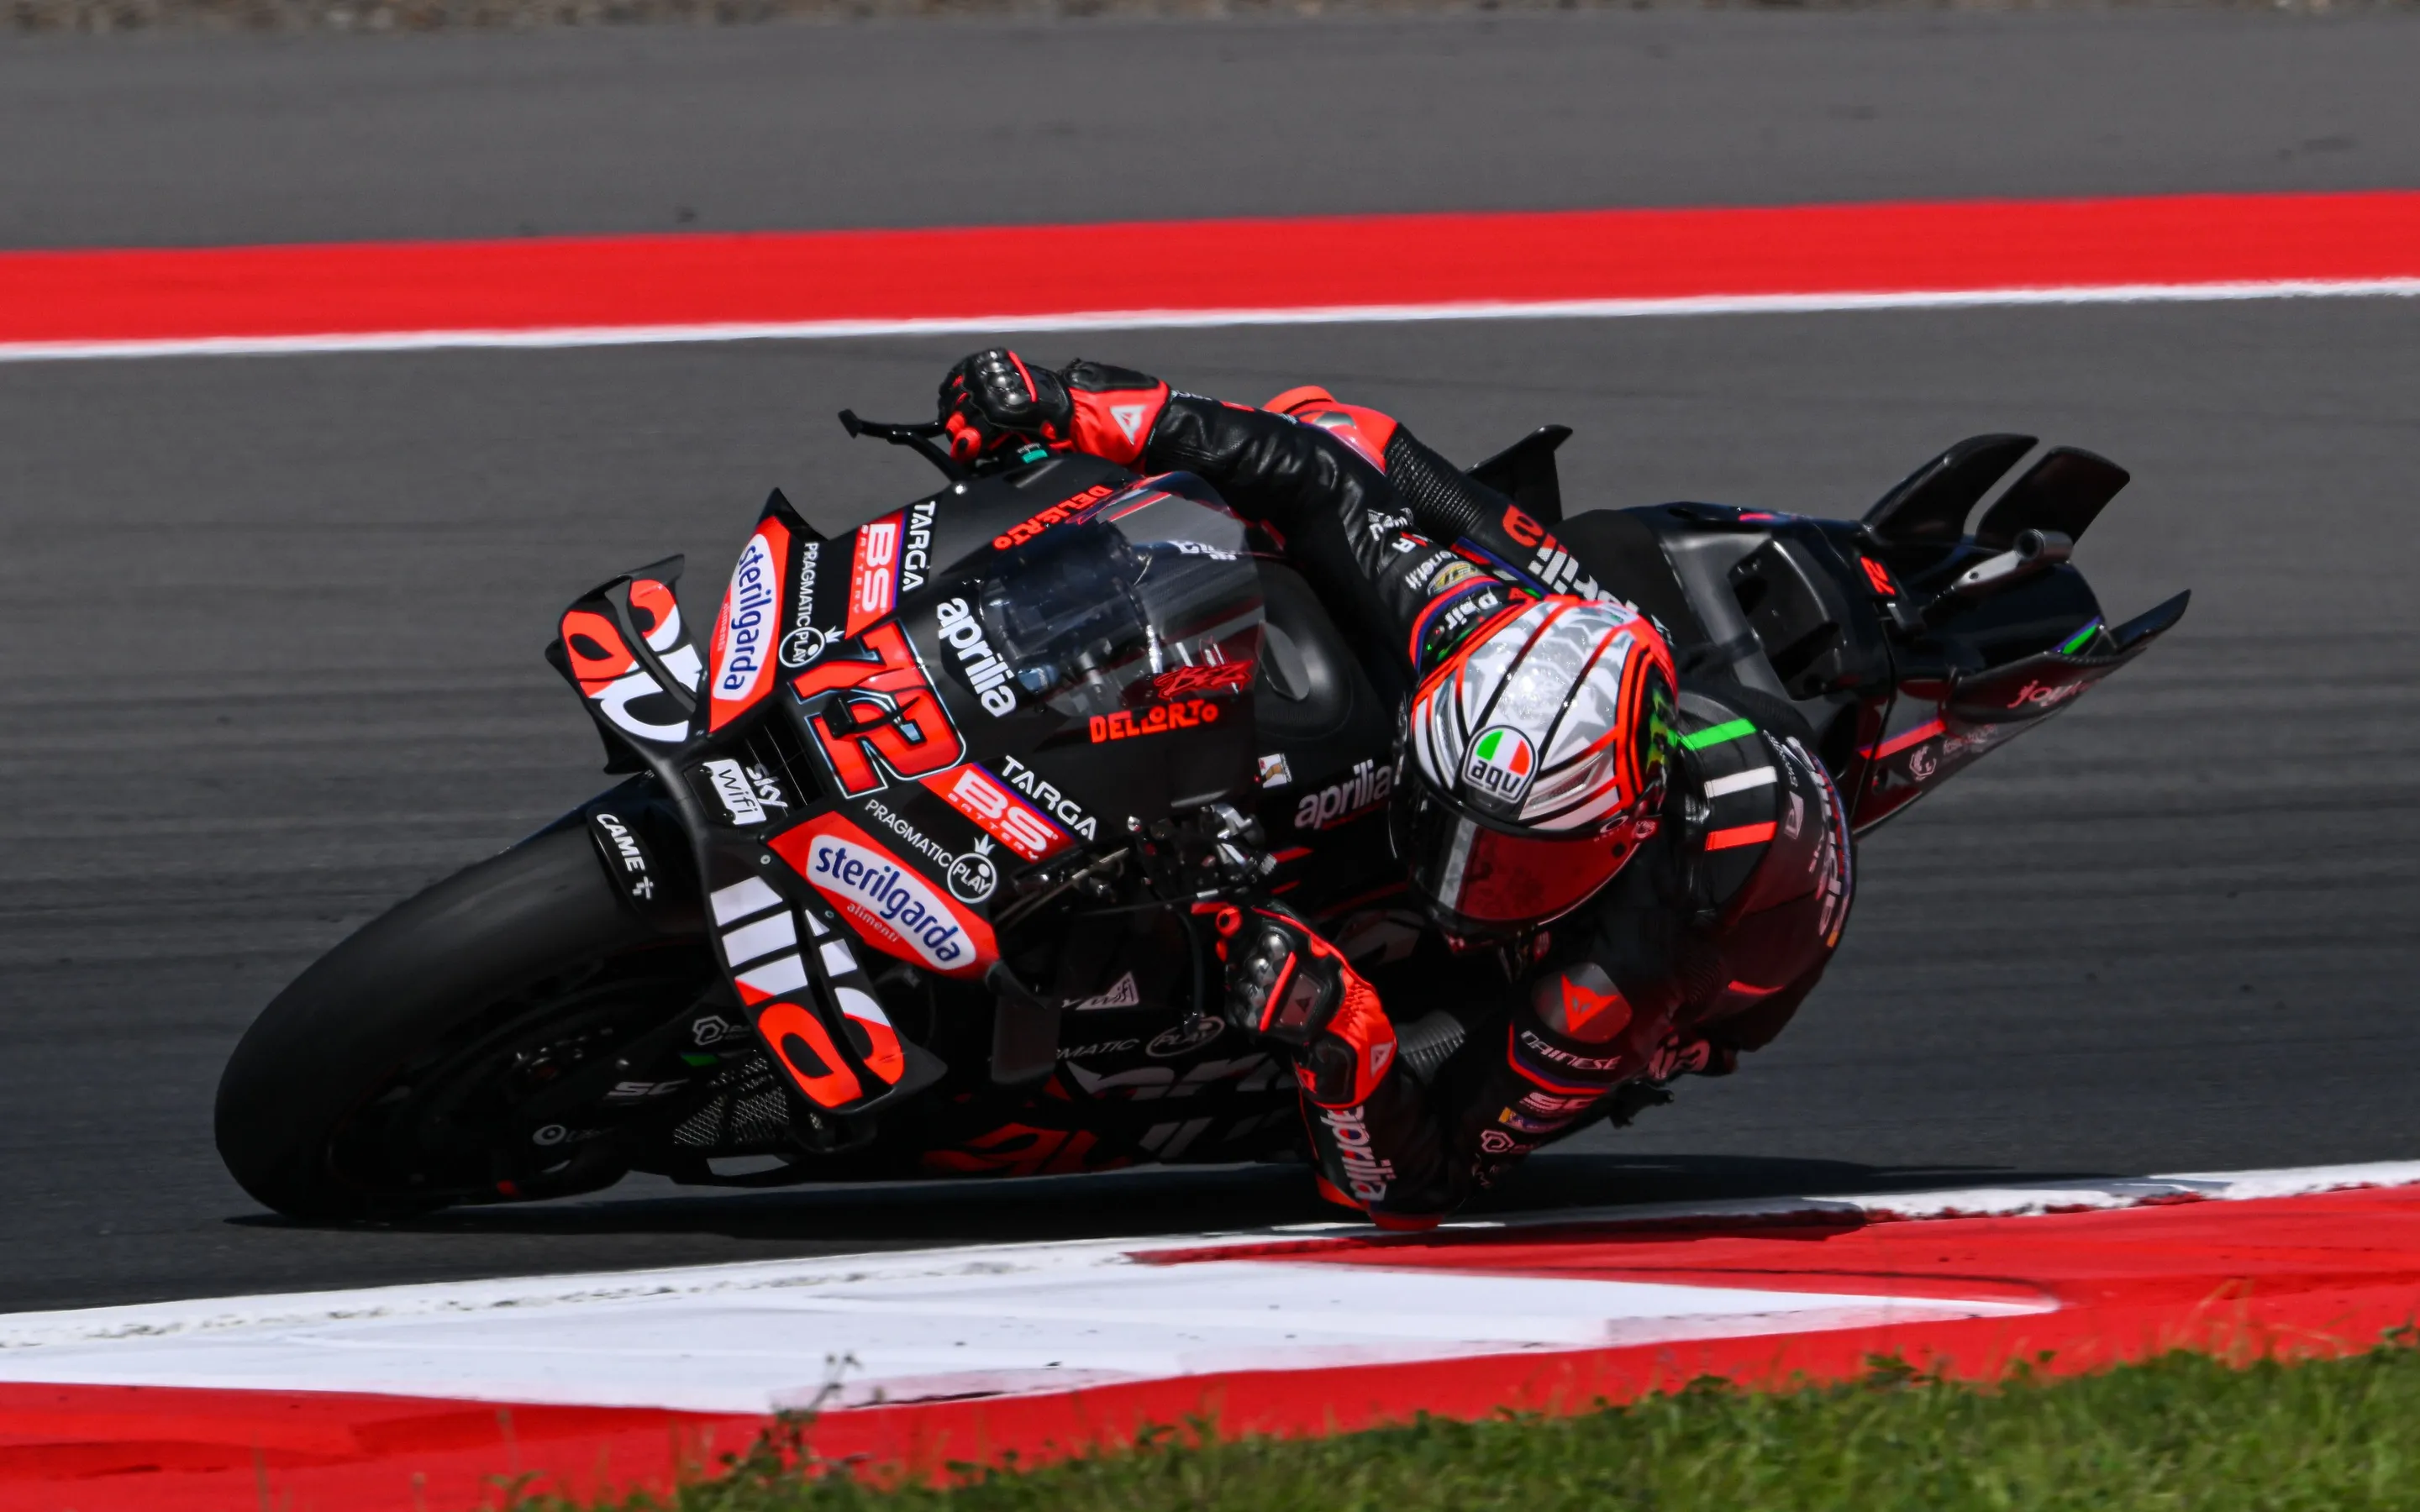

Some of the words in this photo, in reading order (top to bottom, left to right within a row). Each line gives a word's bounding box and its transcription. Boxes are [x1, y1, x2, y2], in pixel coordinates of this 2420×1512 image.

[798, 542, 820, 627] PRAGMATIC
[853, 524, 868, 614] BATTERY
[862, 522, 897, 612] BS
[902, 501, 936, 591] TARGA
[724, 545, 773, 690] sterilgarda
[792, 632, 818, 665] PLAY
[938, 597, 1018, 717] aprilia
[788, 618, 966, 799] 72
[1090, 699, 1219, 743] DELLORTO
[717, 768, 760, 816] wifi
[747, 764, 788, 811] sky
[947, 791, 1040, 861] BATTERY
[954, 768, 1055, 851] BS
[1001, 756, 1098, 840] TARGA
[1294, 759, 1392, 830] aprilia
[596, 812, 646, 872] CAME
[865, 799, 951, 869] PRAGMATIC
[951, 863, 992, 896] PLAY
[816, 845, 961, 963] sterilgarda
[846, 901, 901, 942] alimenti
[1057, 1038, 1140, 1059] MATIC
